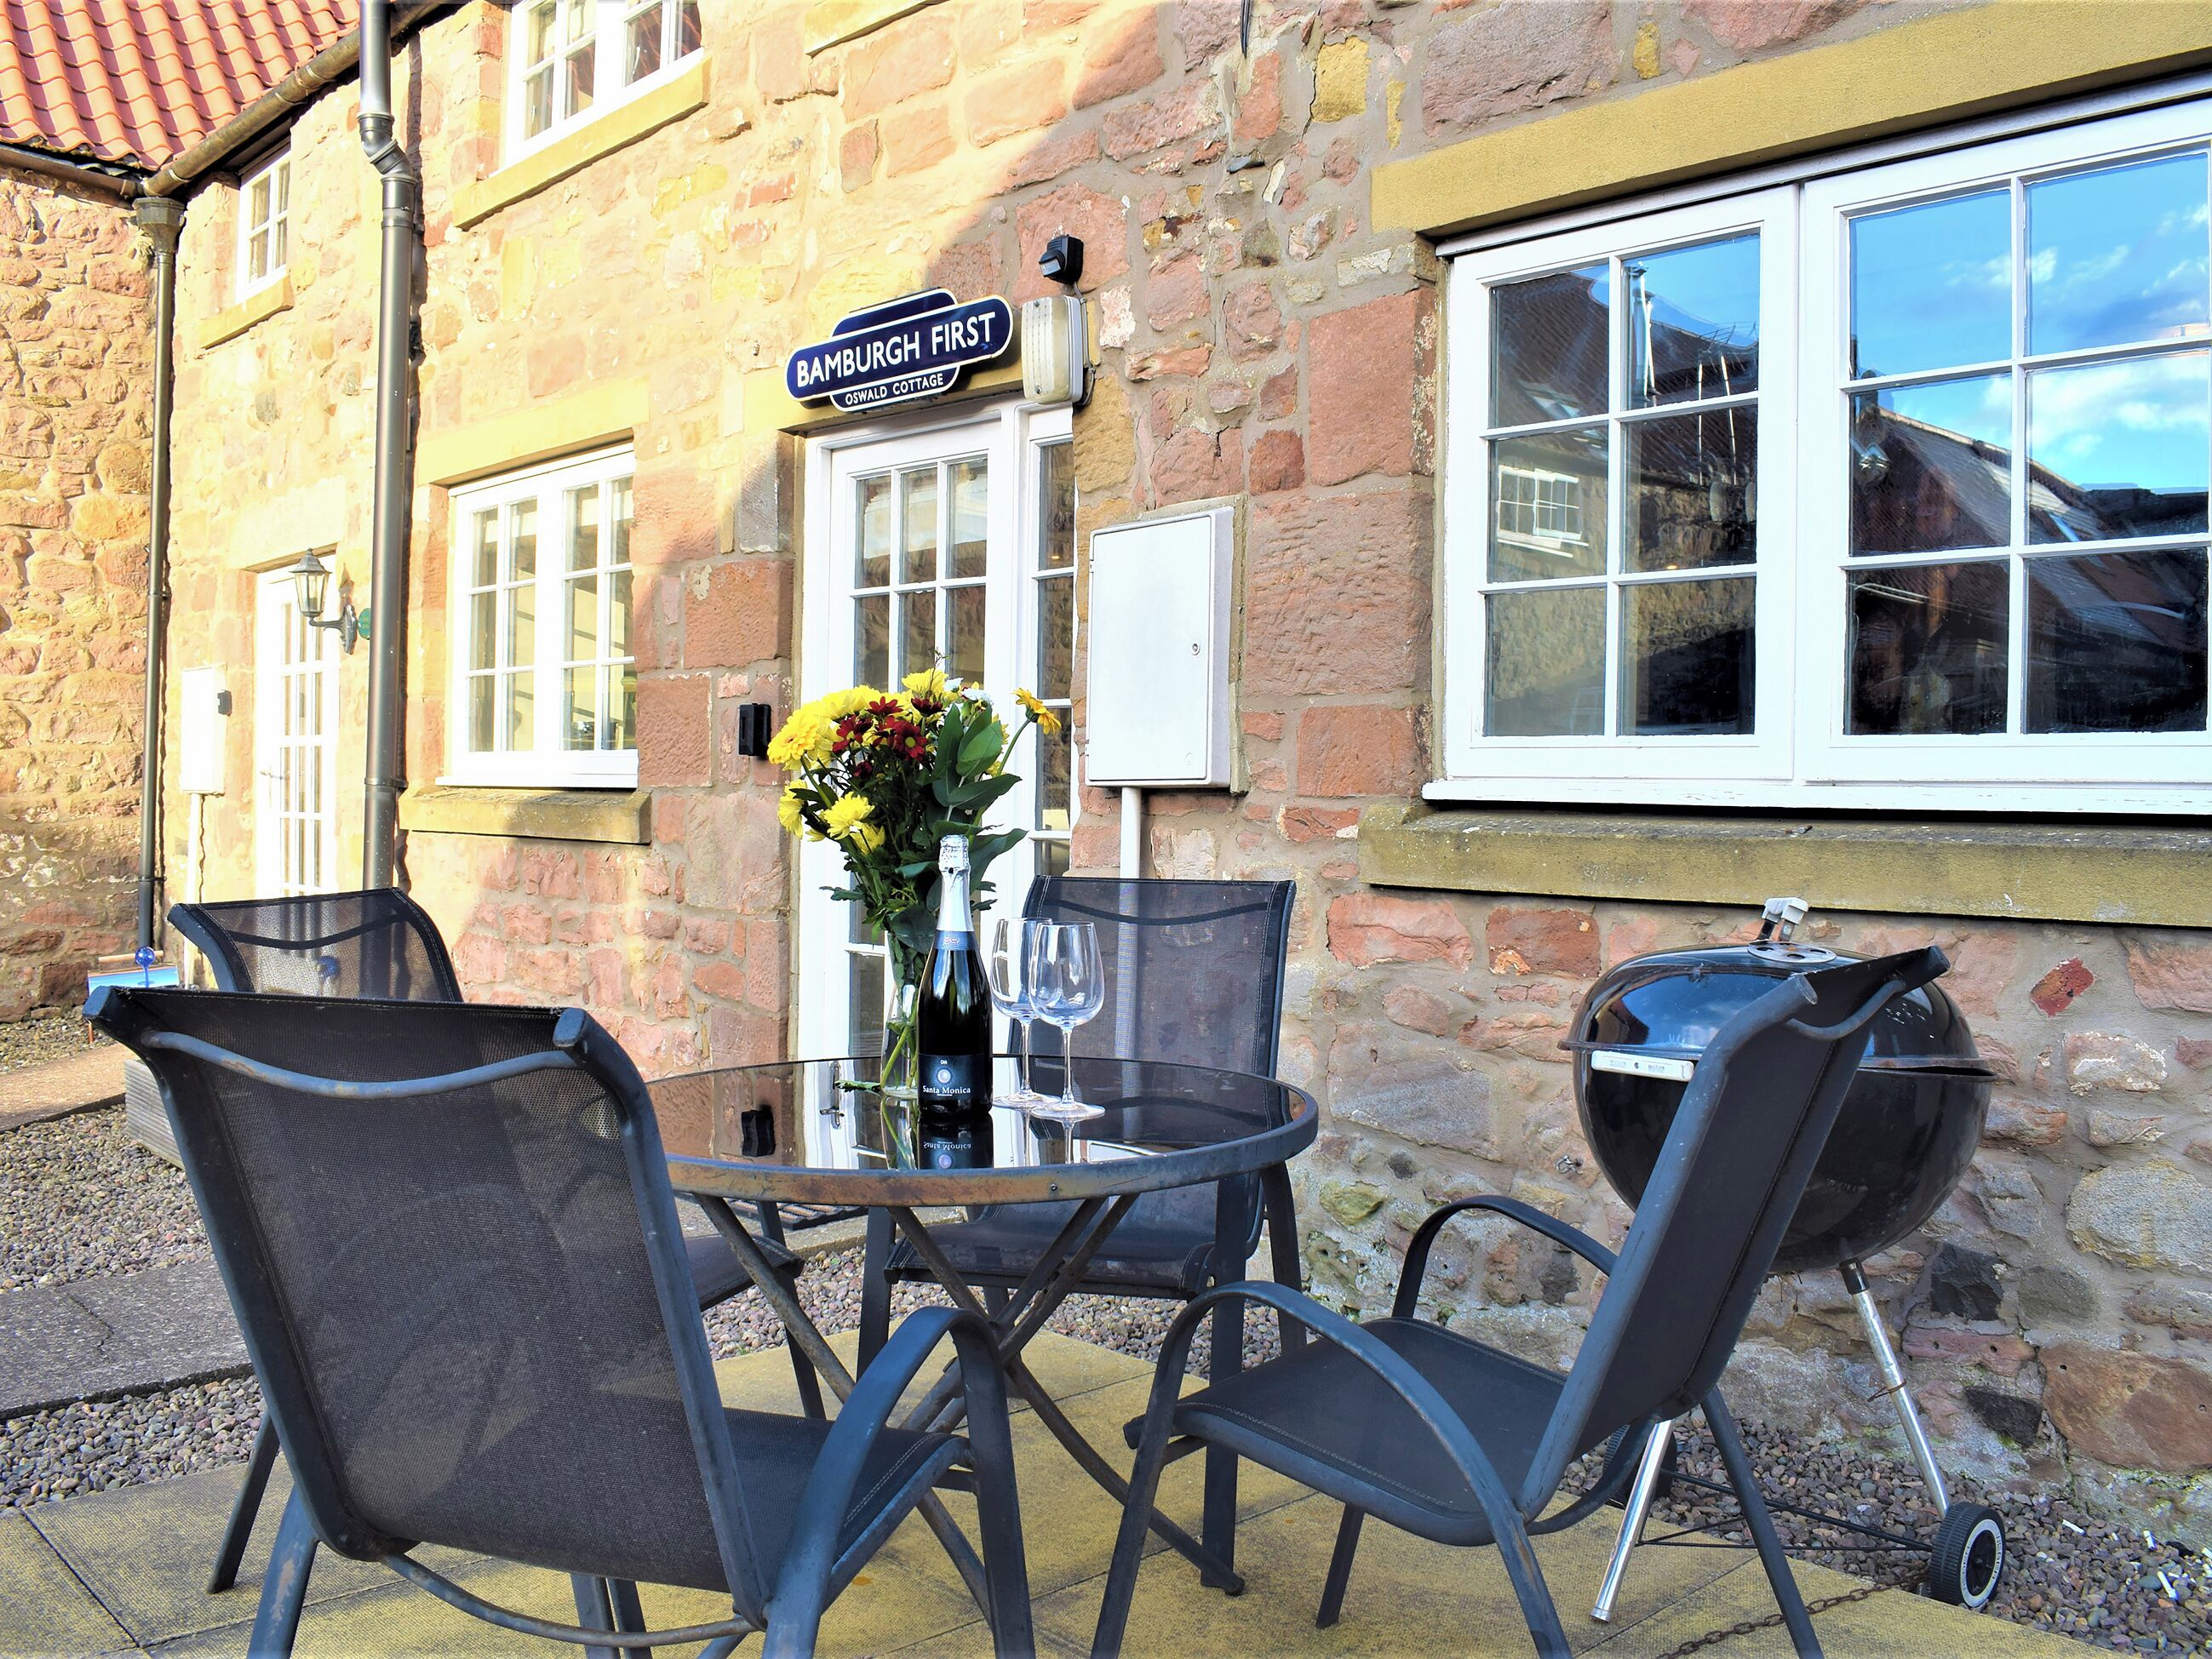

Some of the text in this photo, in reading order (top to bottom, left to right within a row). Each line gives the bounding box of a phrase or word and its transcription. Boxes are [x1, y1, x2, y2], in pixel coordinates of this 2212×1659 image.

[796, 311, 996, 388] BAMBURGH FIRST
[845, 373, 944, 406] OSWALD COTTAGE
[922, 1084, 971, 1095] Santa Monica
